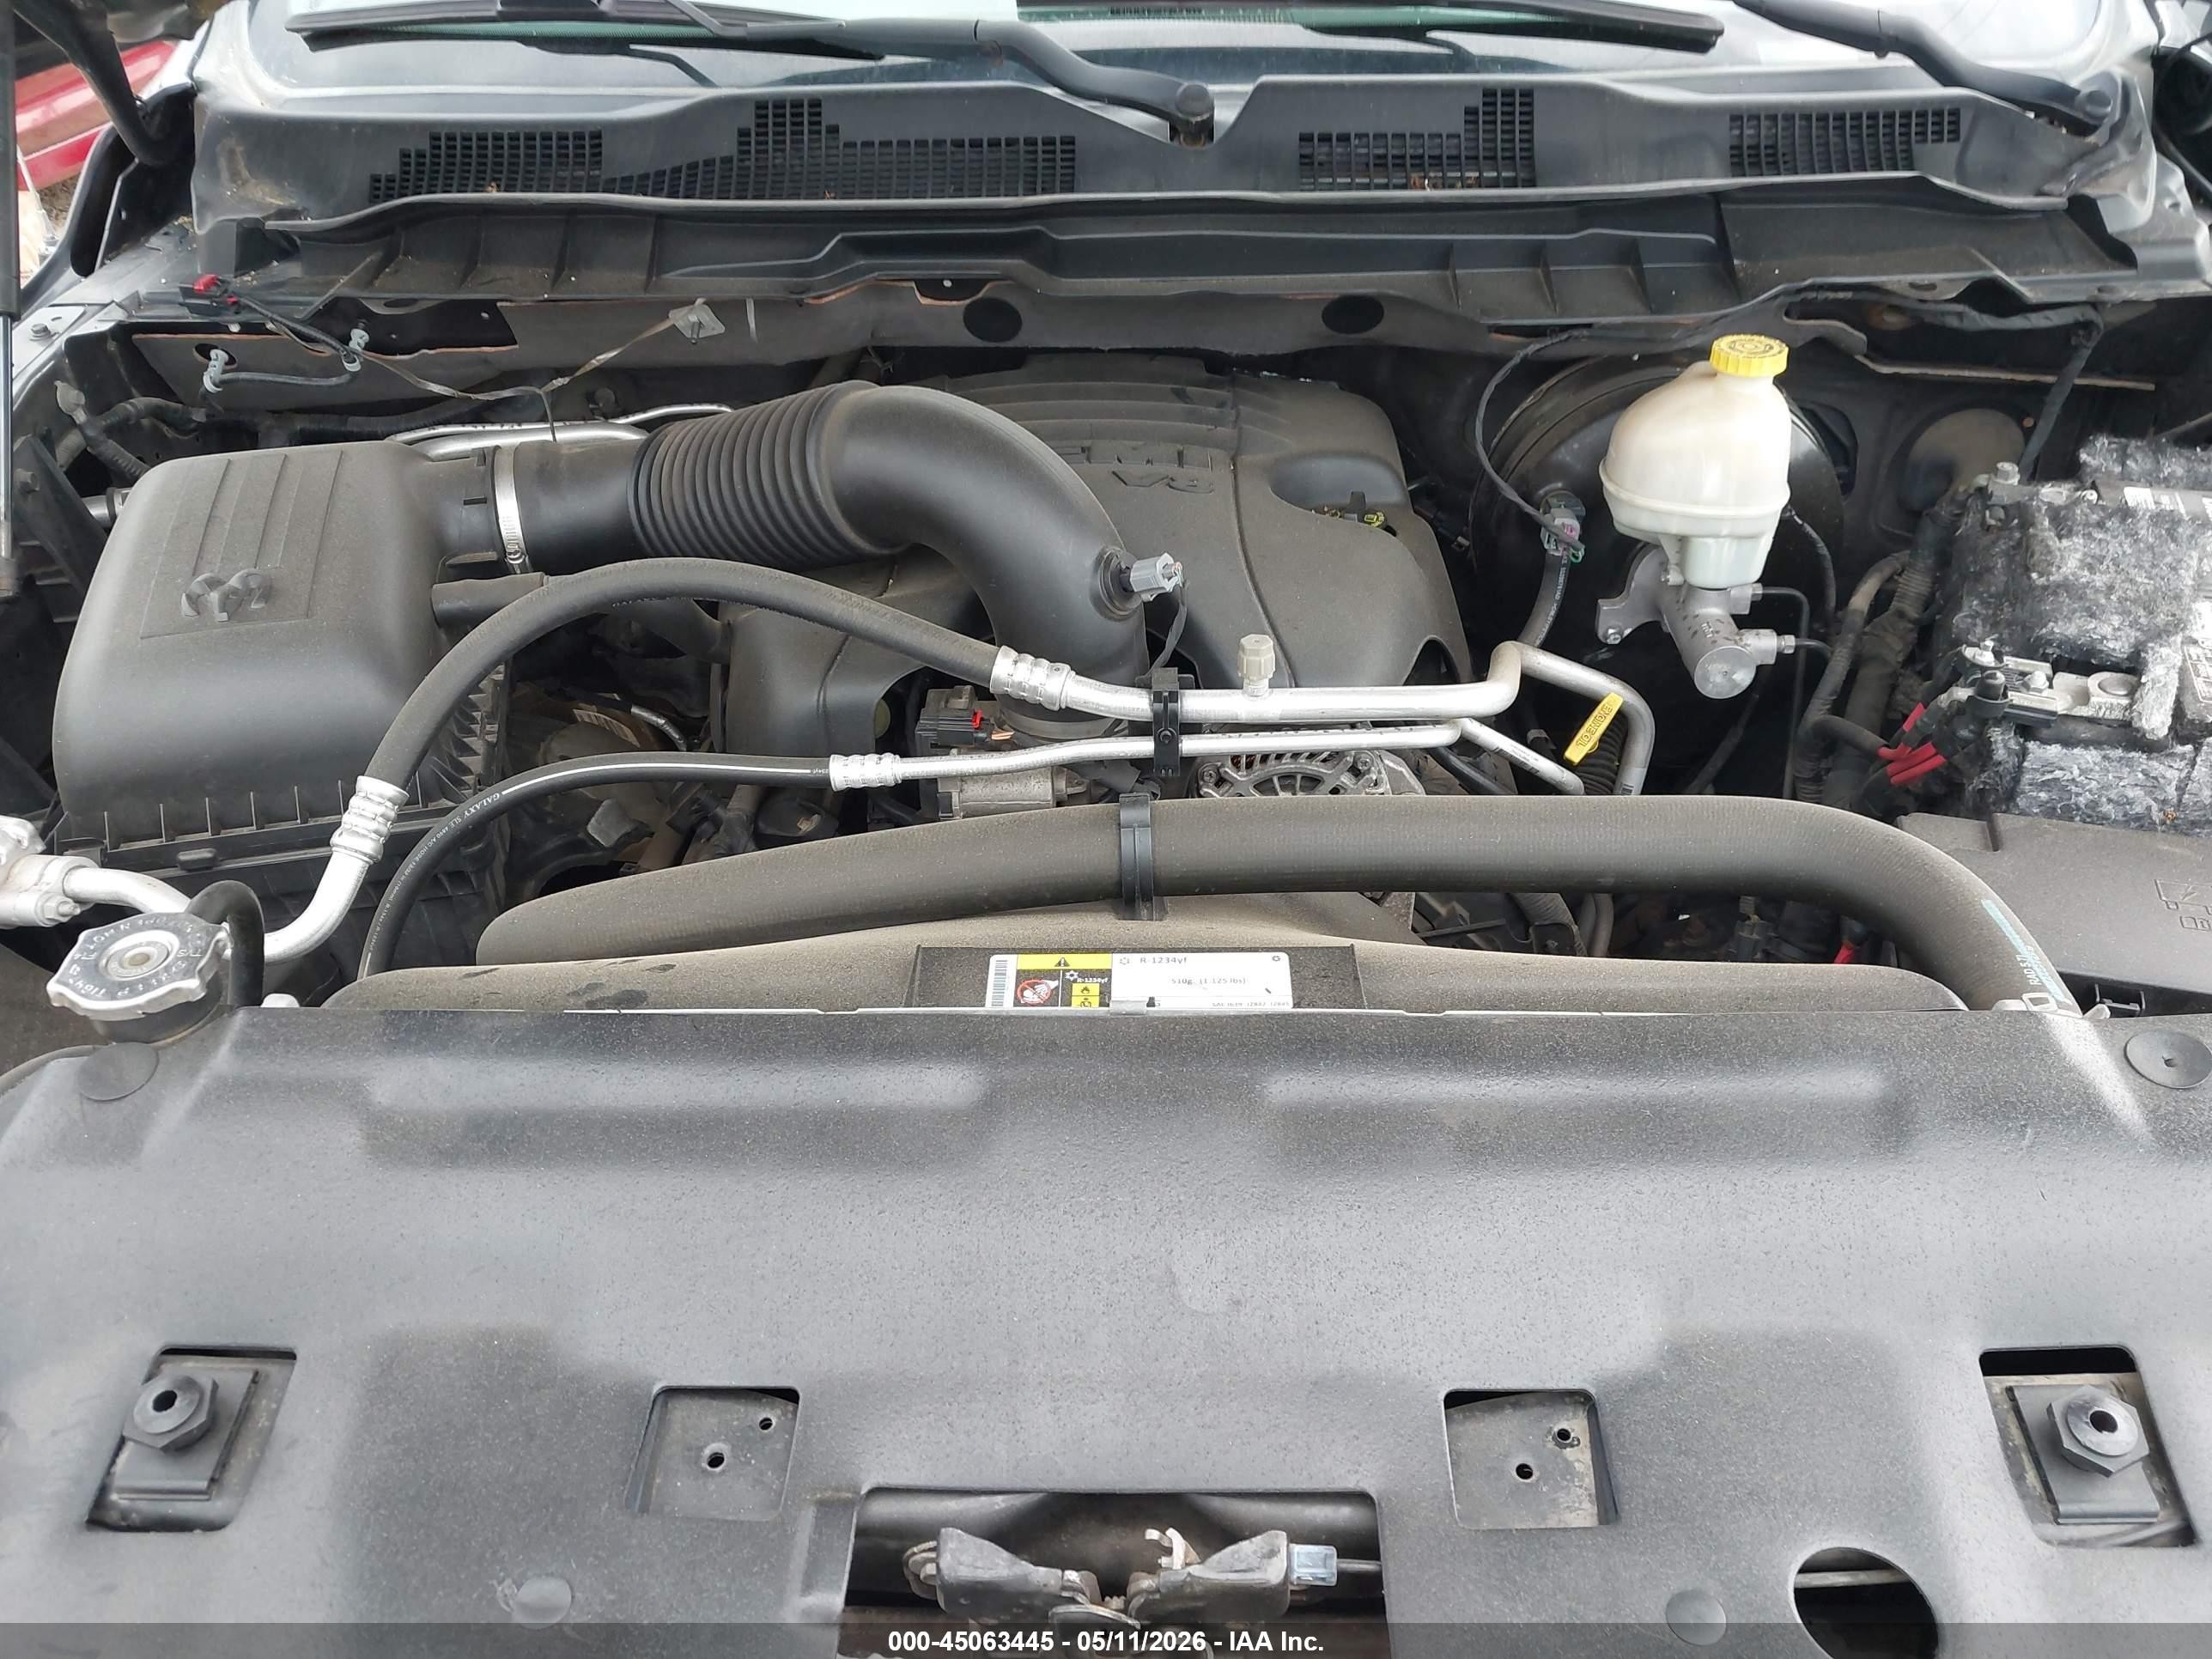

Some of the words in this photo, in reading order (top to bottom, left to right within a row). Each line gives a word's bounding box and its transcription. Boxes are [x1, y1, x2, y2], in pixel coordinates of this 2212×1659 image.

[1586, 703, 1613, 736] ENGINE
[1576, 734, 1592, 747] OIL
[463, 793, 501, 819] GALAXY
